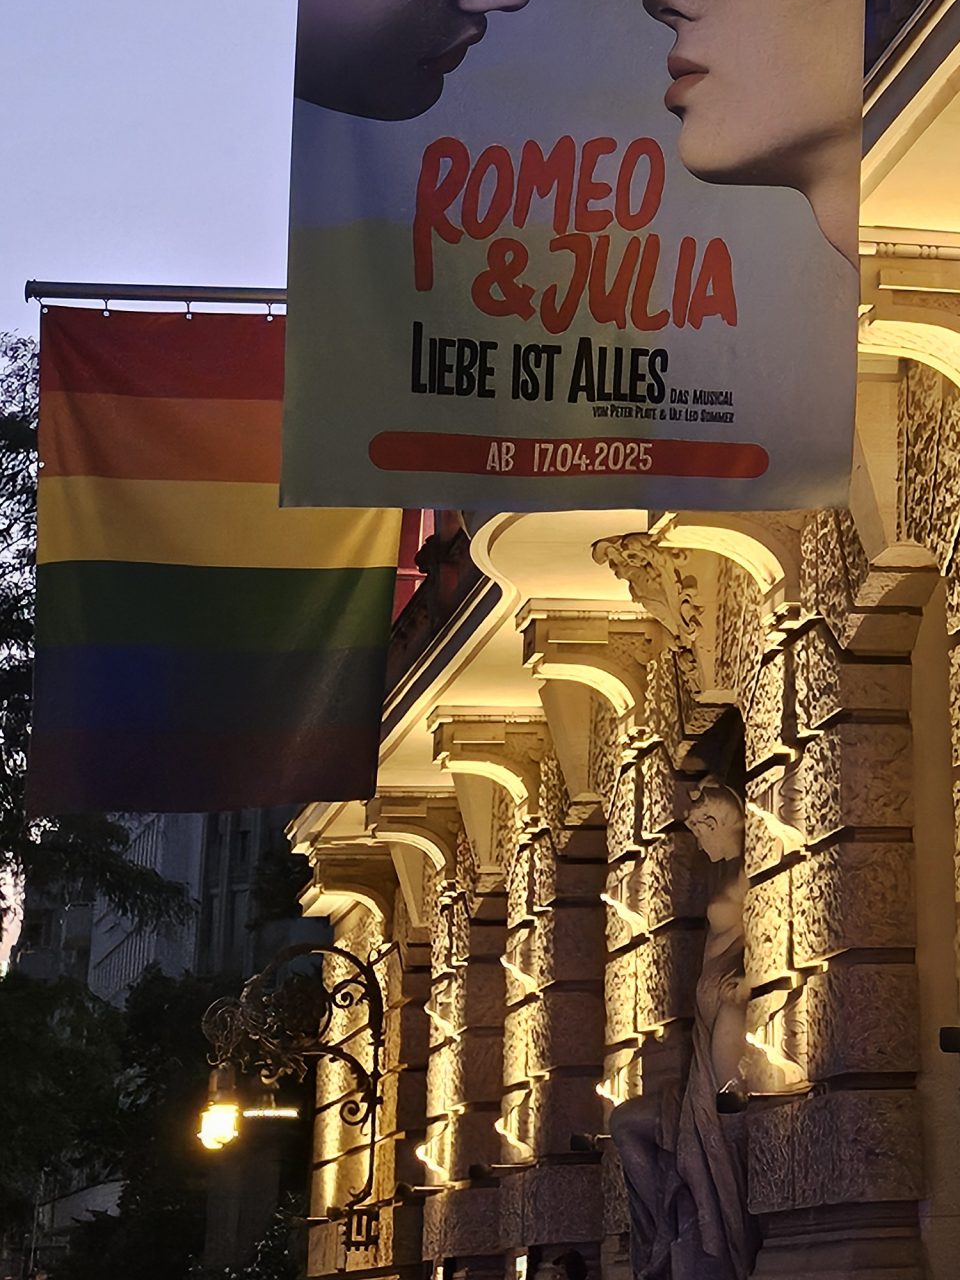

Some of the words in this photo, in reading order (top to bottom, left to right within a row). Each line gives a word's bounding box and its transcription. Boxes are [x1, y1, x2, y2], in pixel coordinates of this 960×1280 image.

[413, 135, 666, 292] ROMEO
[411, 321, 498, 399] LIEBE
[511, 343, 562, 401] IST
[568, 336, 669, 404] ALLES
[670, 389, 689, 405] DAS
[692, 389, 734, 407] MUSICAL
[486, 442, 514, 472] AB
[533, 442, 654, 472] 17.04.2025
